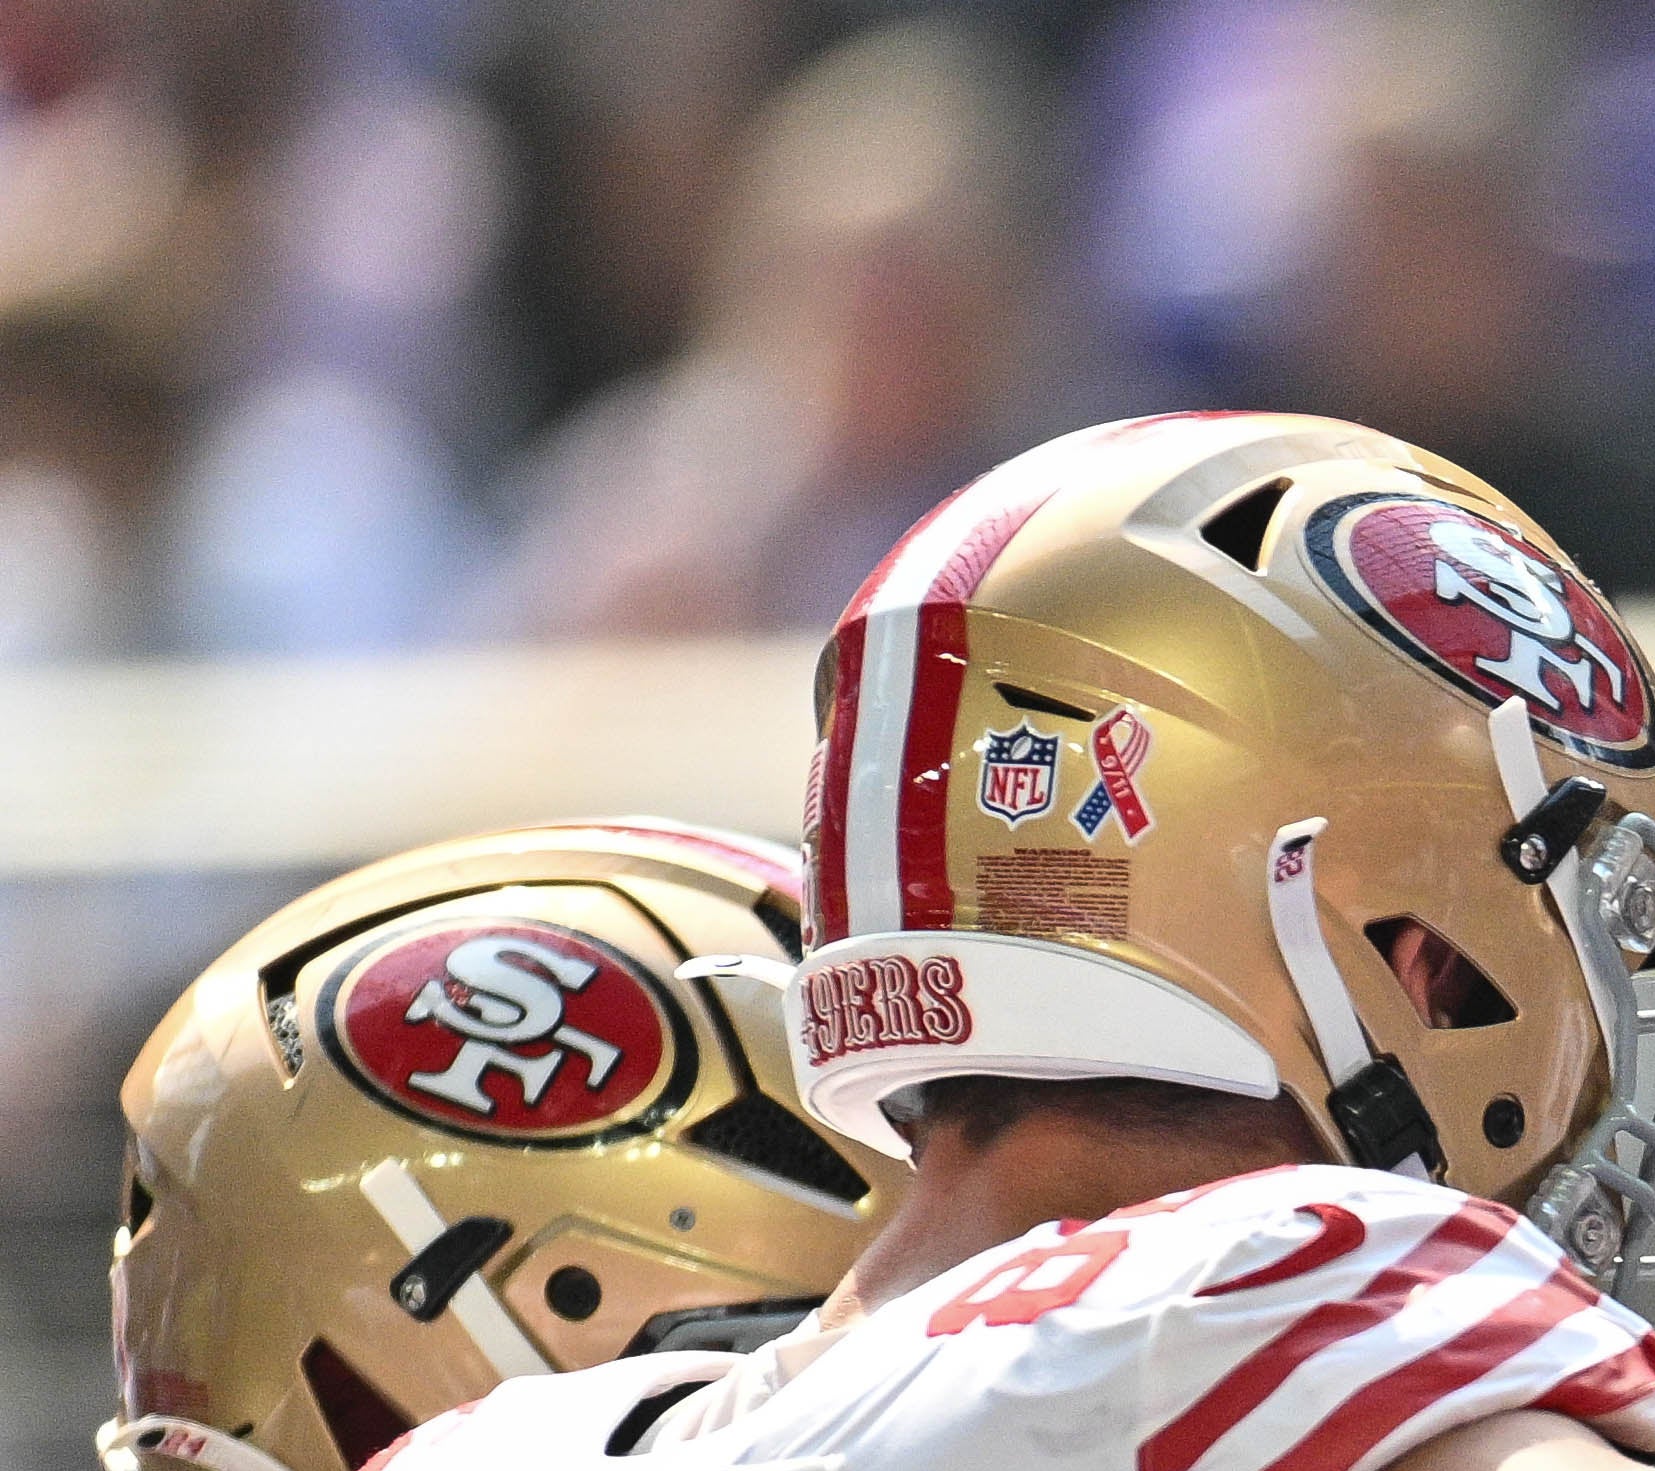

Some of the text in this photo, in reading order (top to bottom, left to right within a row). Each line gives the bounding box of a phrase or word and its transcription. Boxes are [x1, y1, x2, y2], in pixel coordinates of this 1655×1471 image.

[1427, 520, 1625, 714] SF
[985, 766, 1045, 811] NFL
[404, 935, 623, 1117] SF
